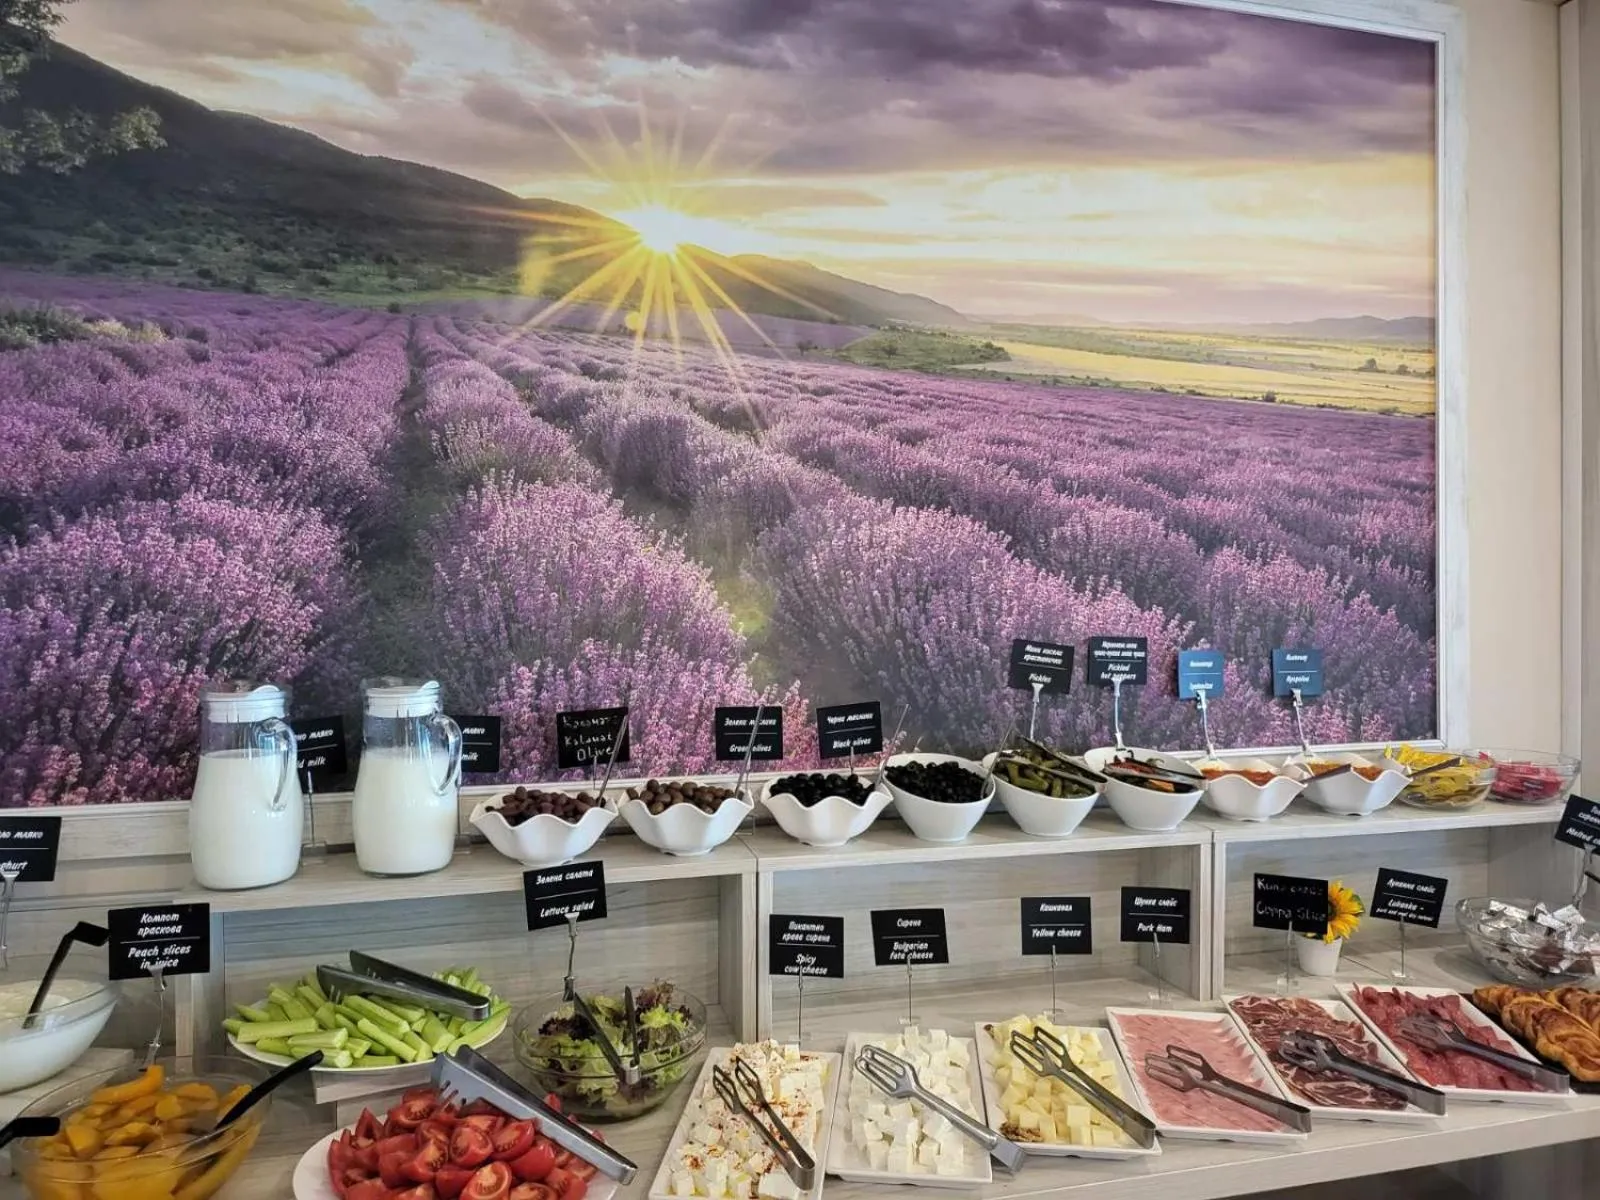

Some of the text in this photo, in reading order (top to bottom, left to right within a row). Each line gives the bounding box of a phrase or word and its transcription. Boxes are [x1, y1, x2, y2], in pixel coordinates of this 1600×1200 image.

[307, 756, 326, 767] milk
[536, 869, 594, 885] Зелена салата
[540, 900, 595, 918] Lettuce salad
[140, 913, 180, 924] Компот
[137, 925, 183, 938] праскова
[1032, 927, 1082, 938] Yellow cheese
[1137, 922, 1154, 932] Pork
[128, 944, 192, 958] Peach slices
[893, 941, 929, 953] Bulgarian
[795, 953, 817, 966] Spicy
[907, 951, 934, 960] cheese
[140, 959, 151, 969] in
[802, 966, 828, 975] cheese
